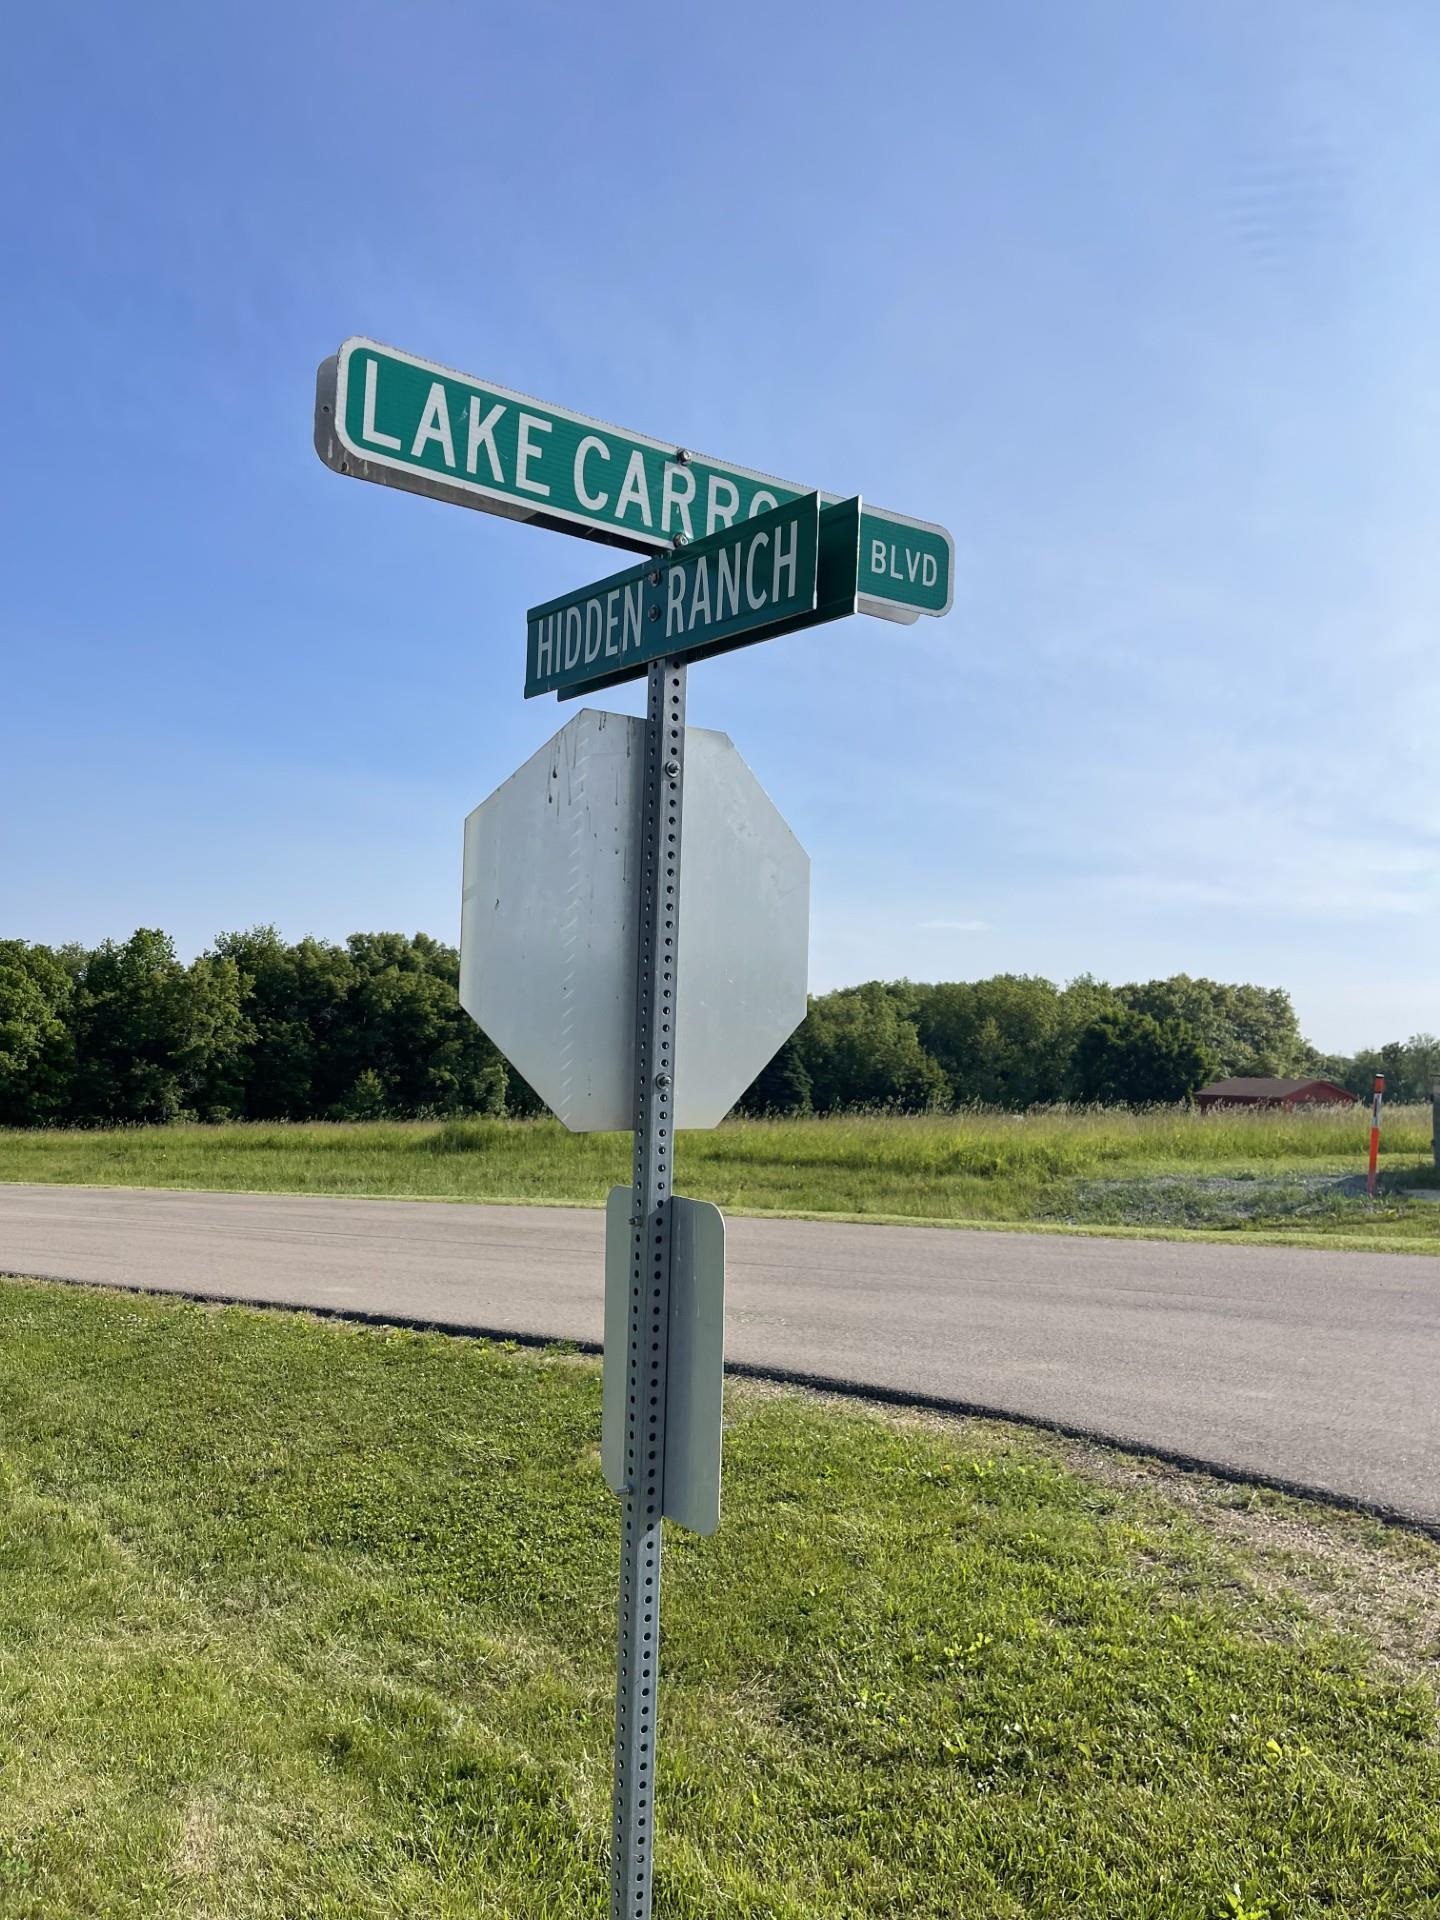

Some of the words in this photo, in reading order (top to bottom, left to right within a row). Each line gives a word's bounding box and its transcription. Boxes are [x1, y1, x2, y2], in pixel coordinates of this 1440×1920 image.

[362, 360, 553, 497] LAKE
[870, 539, 938, 588] BLVD
[536, 580, 644, 680] HIDDEN
[665, 519, 799, 637] RANCH
